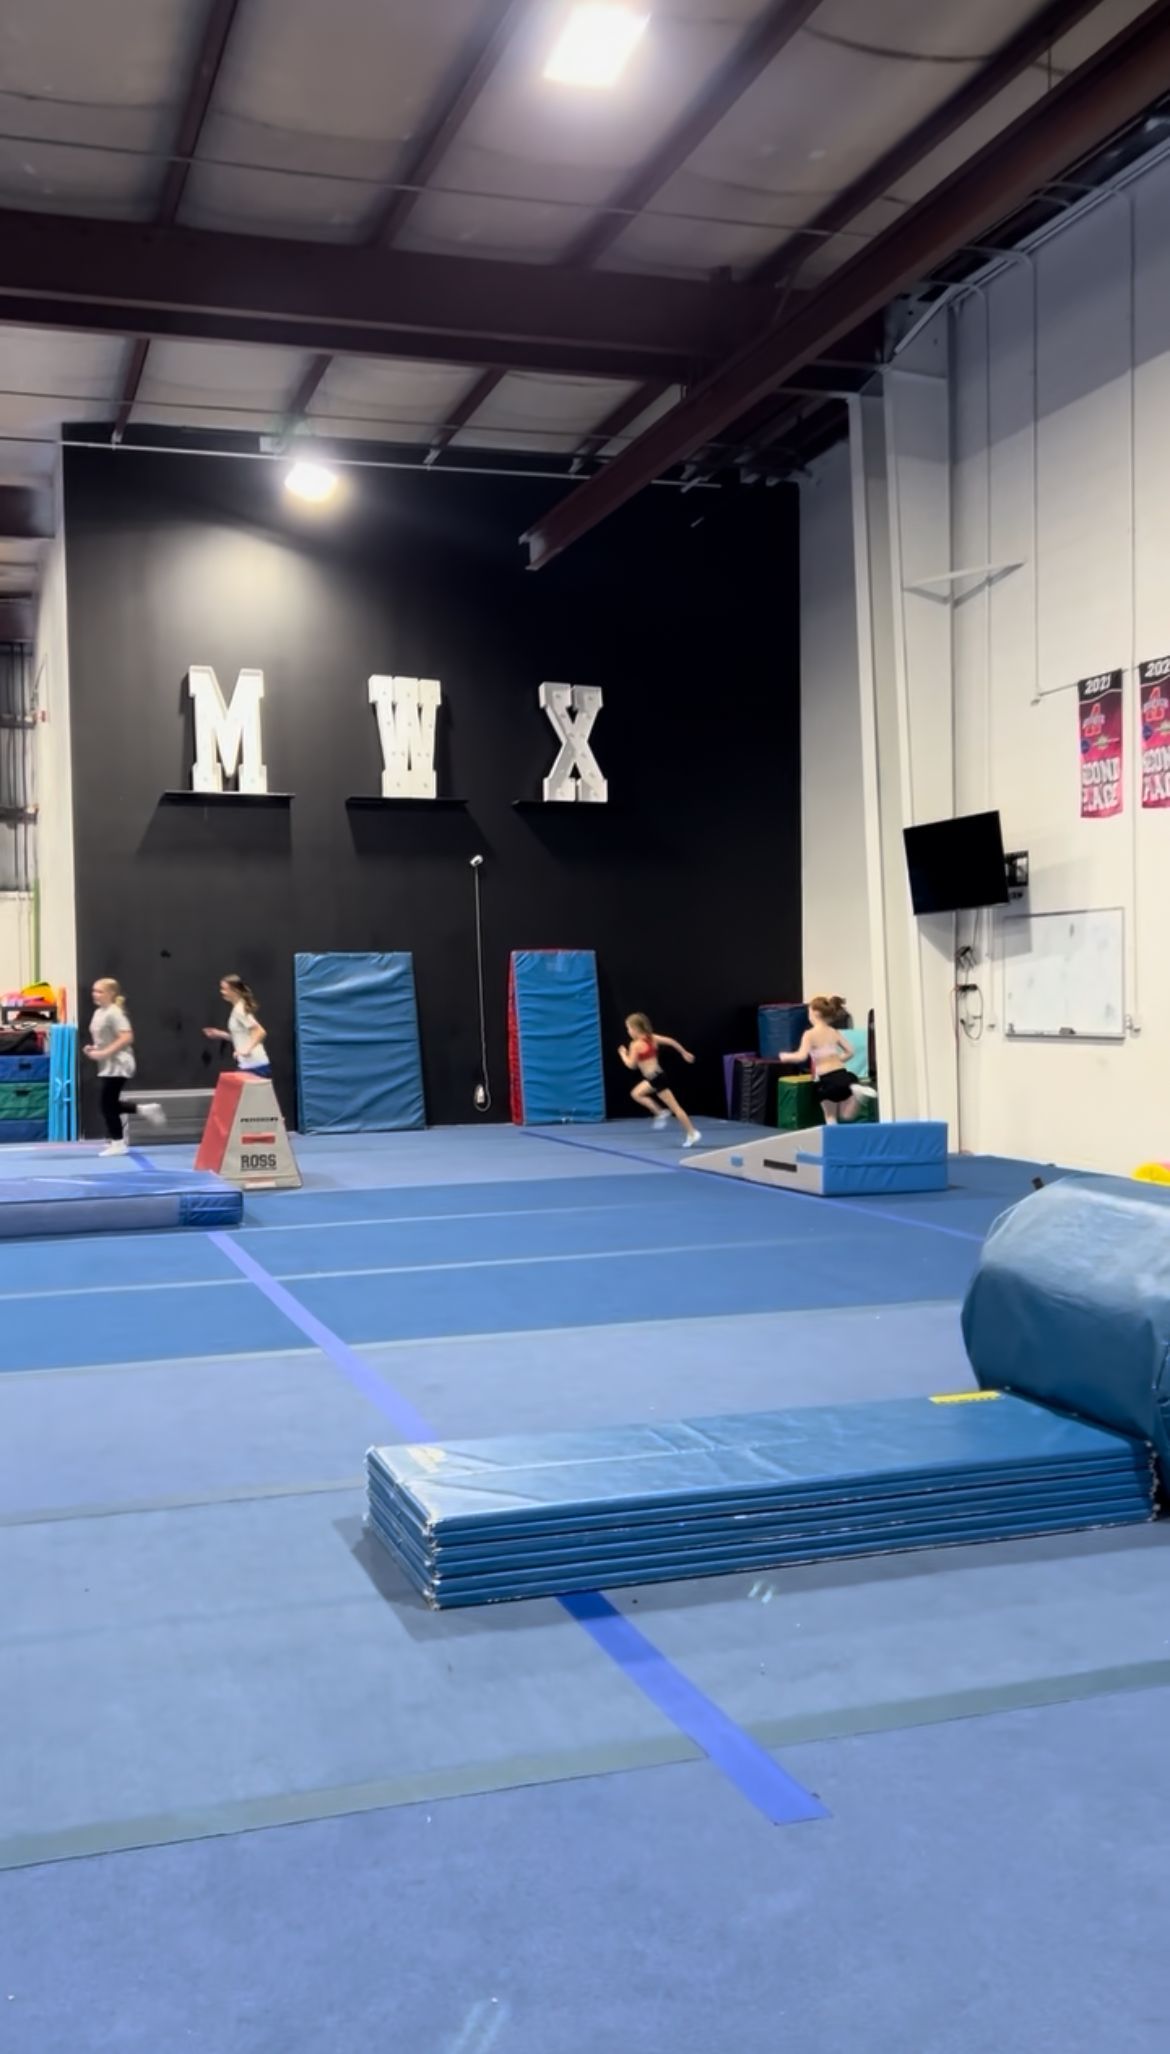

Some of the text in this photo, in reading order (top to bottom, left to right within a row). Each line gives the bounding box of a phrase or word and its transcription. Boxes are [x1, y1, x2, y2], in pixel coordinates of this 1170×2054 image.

[1145, 659, 1170, 677] 202
[1084, 675, 1111, 694] 2021
[188, 665, 608, 803] M W X
[240, 1153, 277, 1169] ROSS
